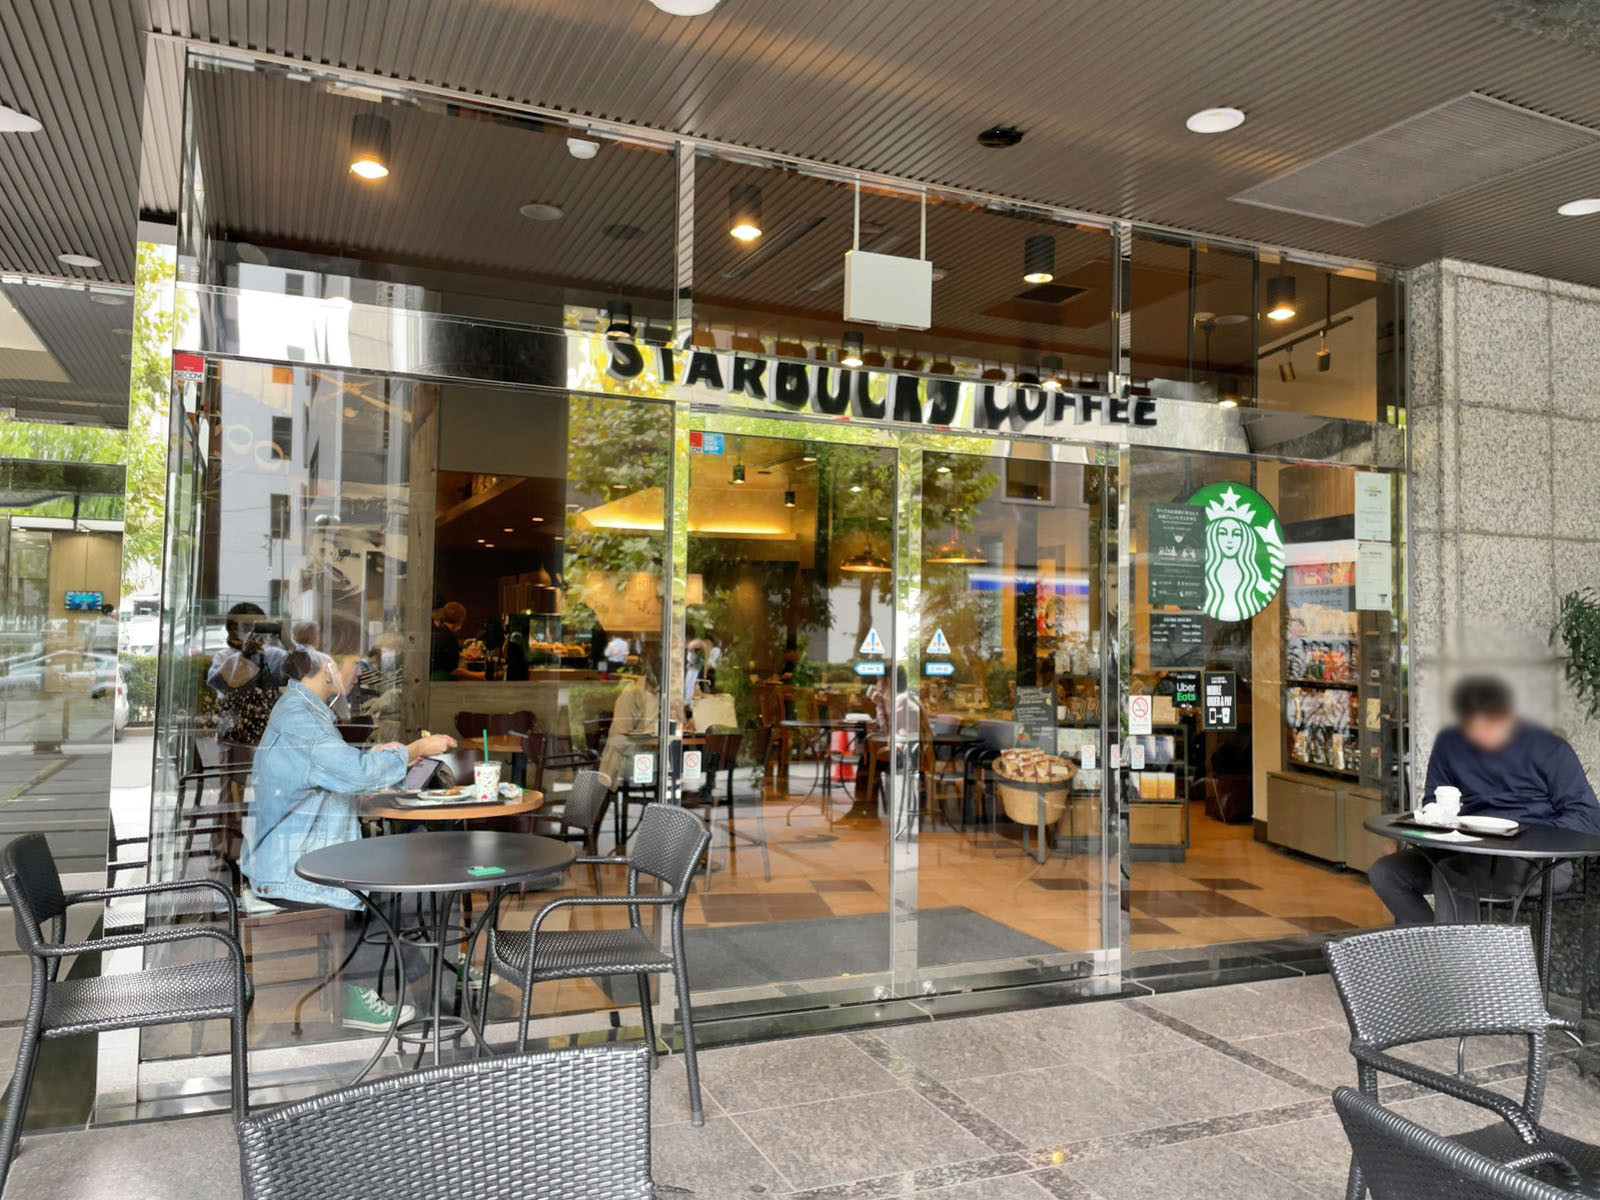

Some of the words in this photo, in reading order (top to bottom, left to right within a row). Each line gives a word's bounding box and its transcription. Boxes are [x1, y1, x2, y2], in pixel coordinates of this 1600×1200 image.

[606, 332, 960, 425] STARBUCKS
[976, 369, 1157, 429] COFFEE
[1176, 682, 1195, 692] Uber
[1176, 692, 1196, 702] Eats
